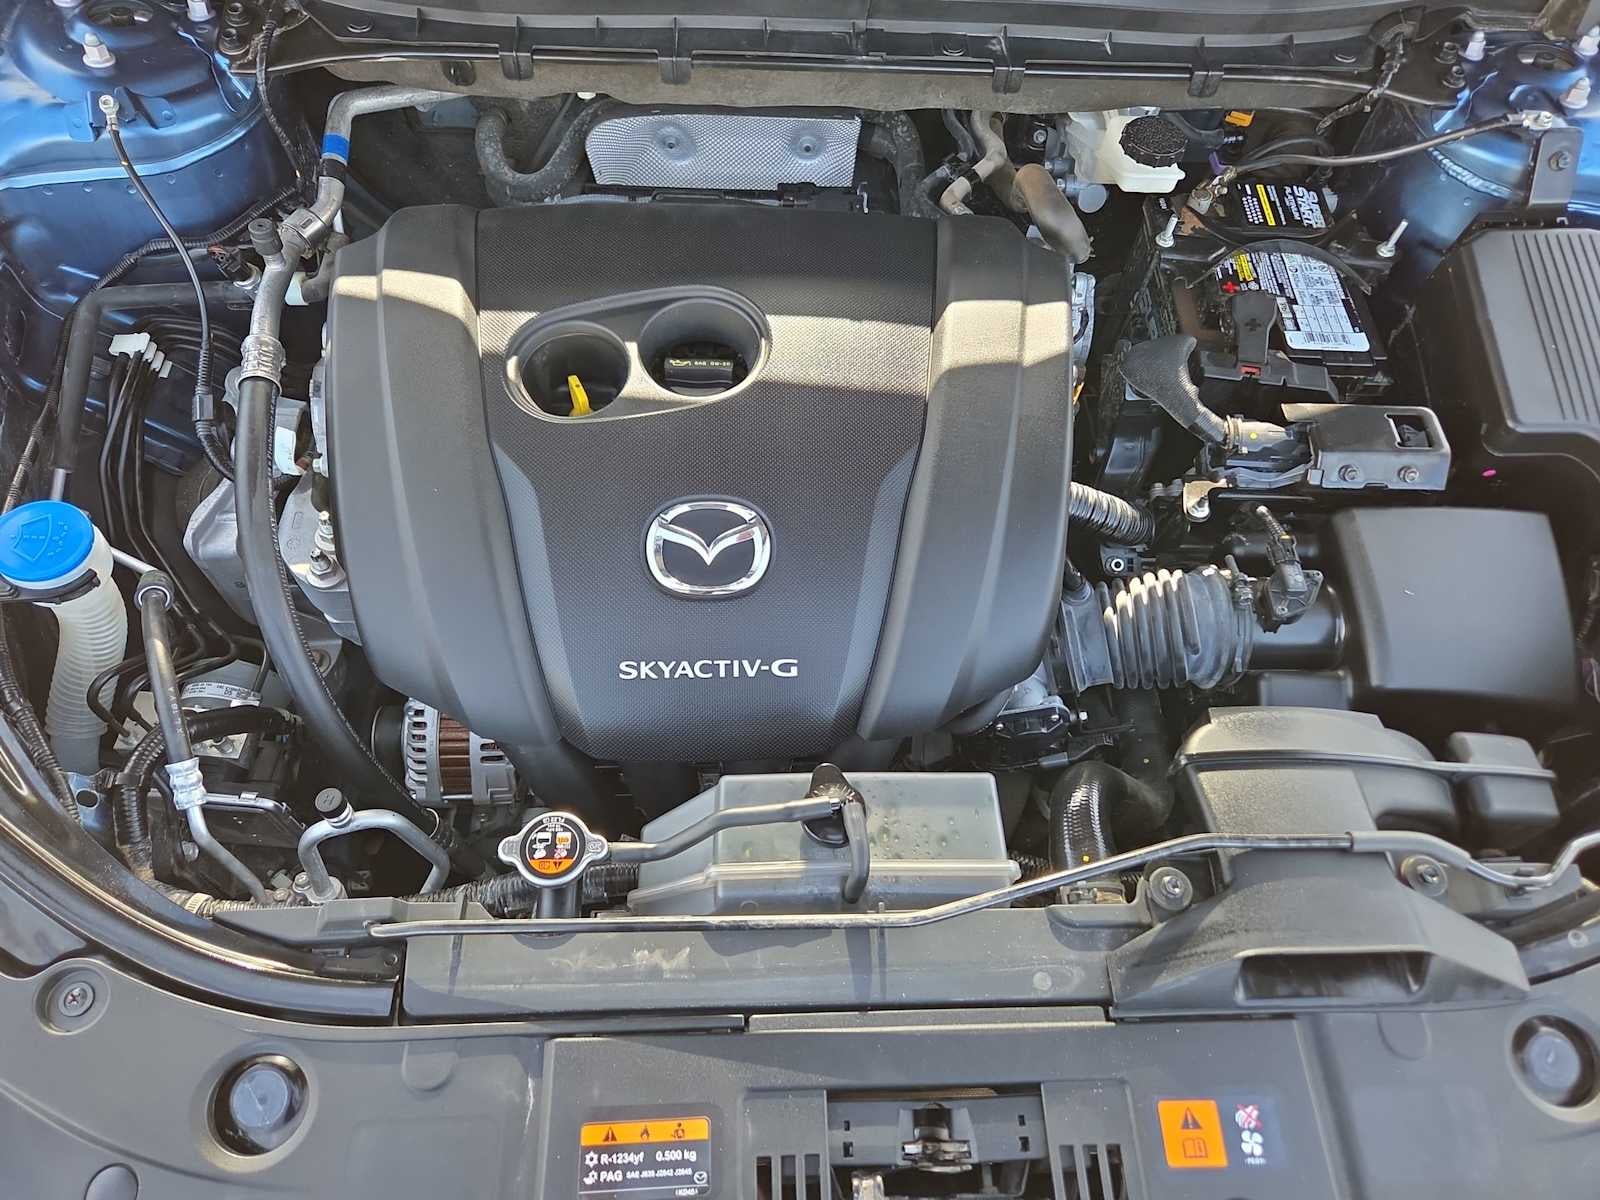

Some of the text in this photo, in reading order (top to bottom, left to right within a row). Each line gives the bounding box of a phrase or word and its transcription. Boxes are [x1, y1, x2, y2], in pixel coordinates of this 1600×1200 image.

[1293, 185, 1314, 227] START
[618, 658, 799, 680] SKYACTIV-G
[599, 1148, 697, 1166] R-1234yf 0.500 kg
[599, 1170, 623, 1183] PAG
